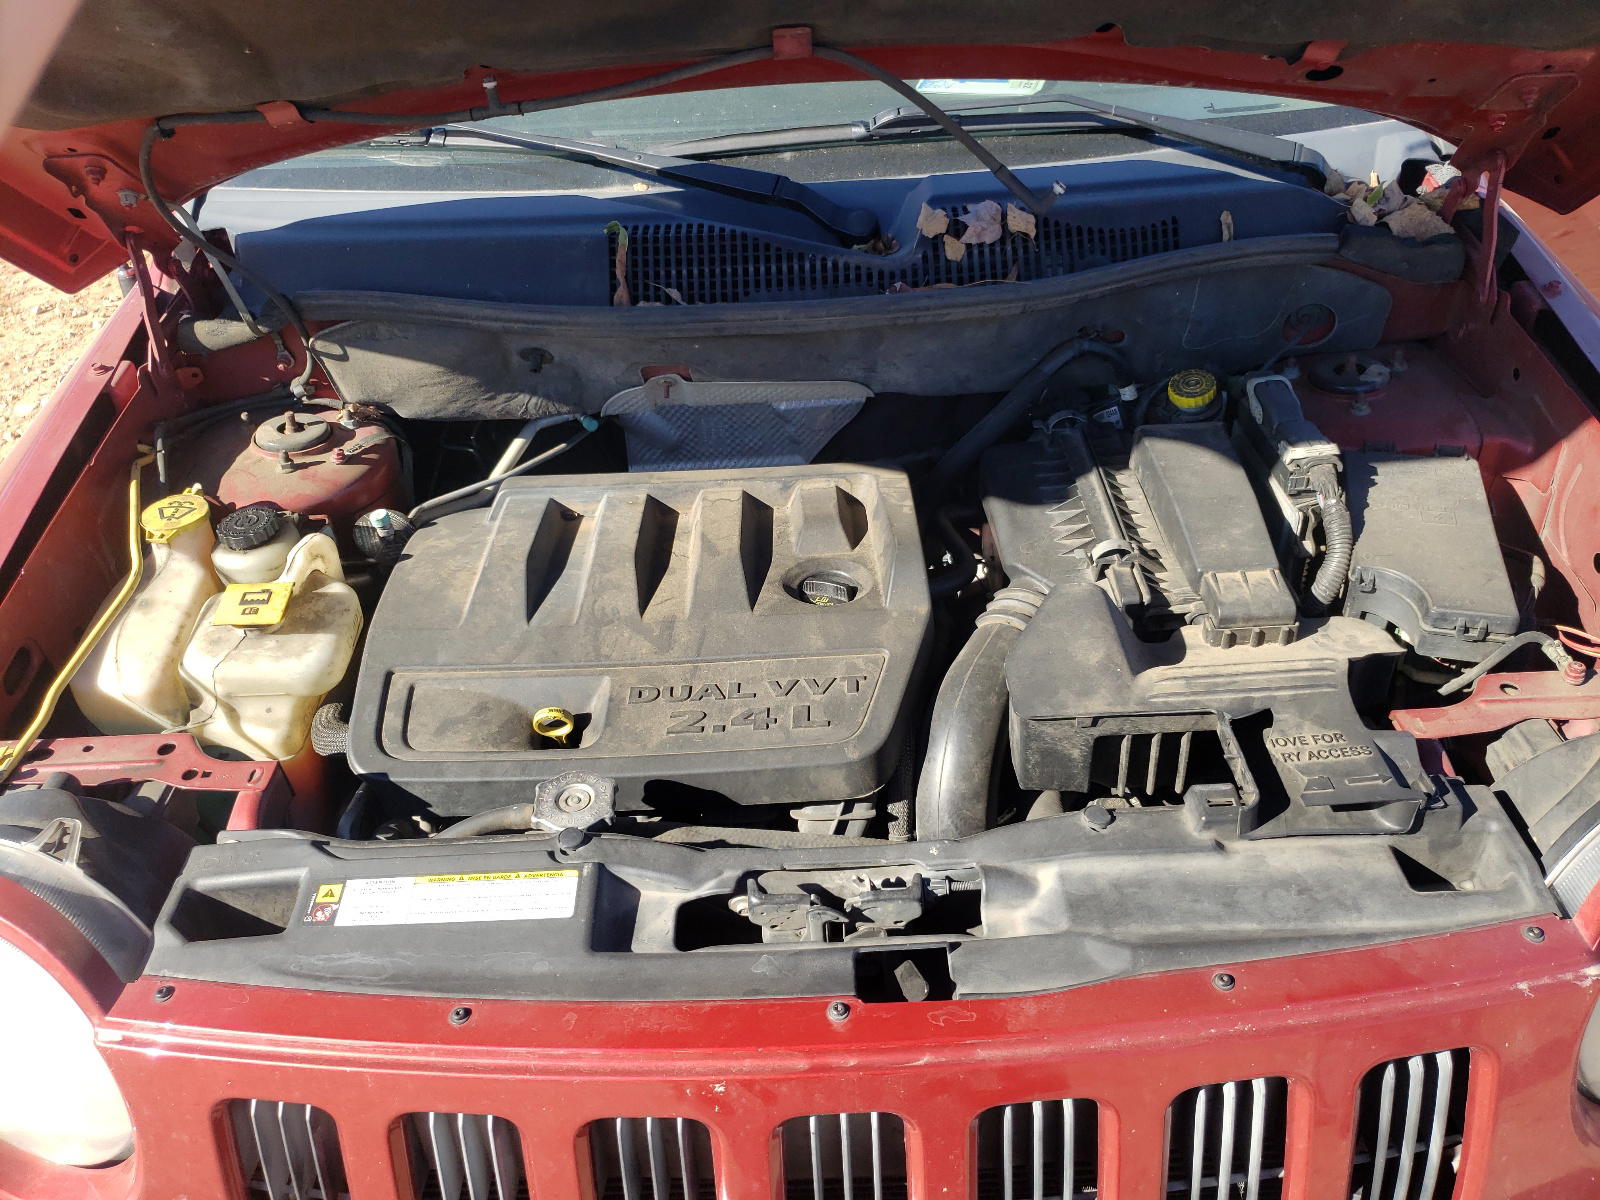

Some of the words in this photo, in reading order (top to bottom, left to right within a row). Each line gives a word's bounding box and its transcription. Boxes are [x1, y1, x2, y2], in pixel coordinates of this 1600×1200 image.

[628, 681, 757, 705] DUAL
[767, 675, 868, 698] VVT
[1310, 732, 1346, 745] FOR
[1307, 745, 1373, 761] ACCESS
